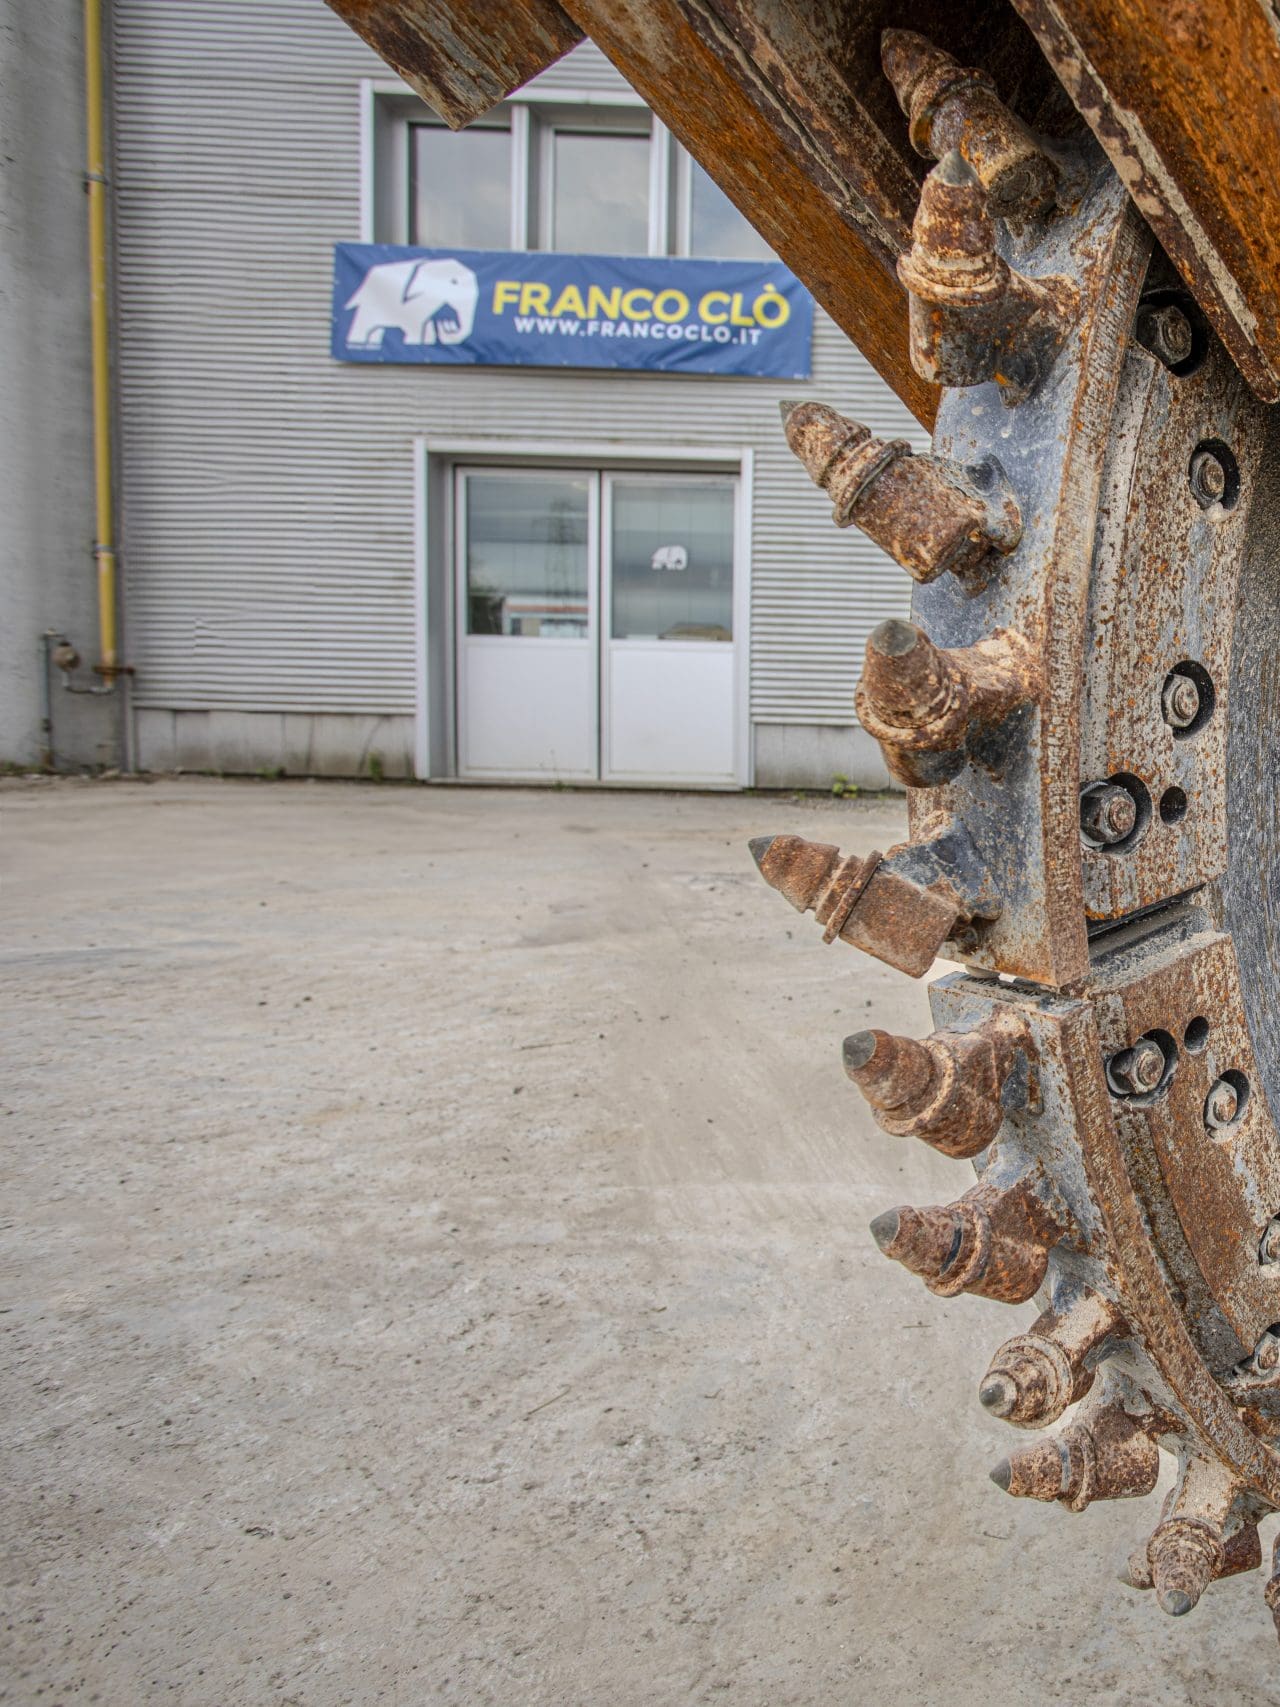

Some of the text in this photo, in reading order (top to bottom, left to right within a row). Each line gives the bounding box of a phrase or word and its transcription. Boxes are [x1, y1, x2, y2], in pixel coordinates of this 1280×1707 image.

[492, 280, 790, 328] FRANCO CLÒ
[513, 316, 762, 345] WWW.FRANCOCLO.IT
